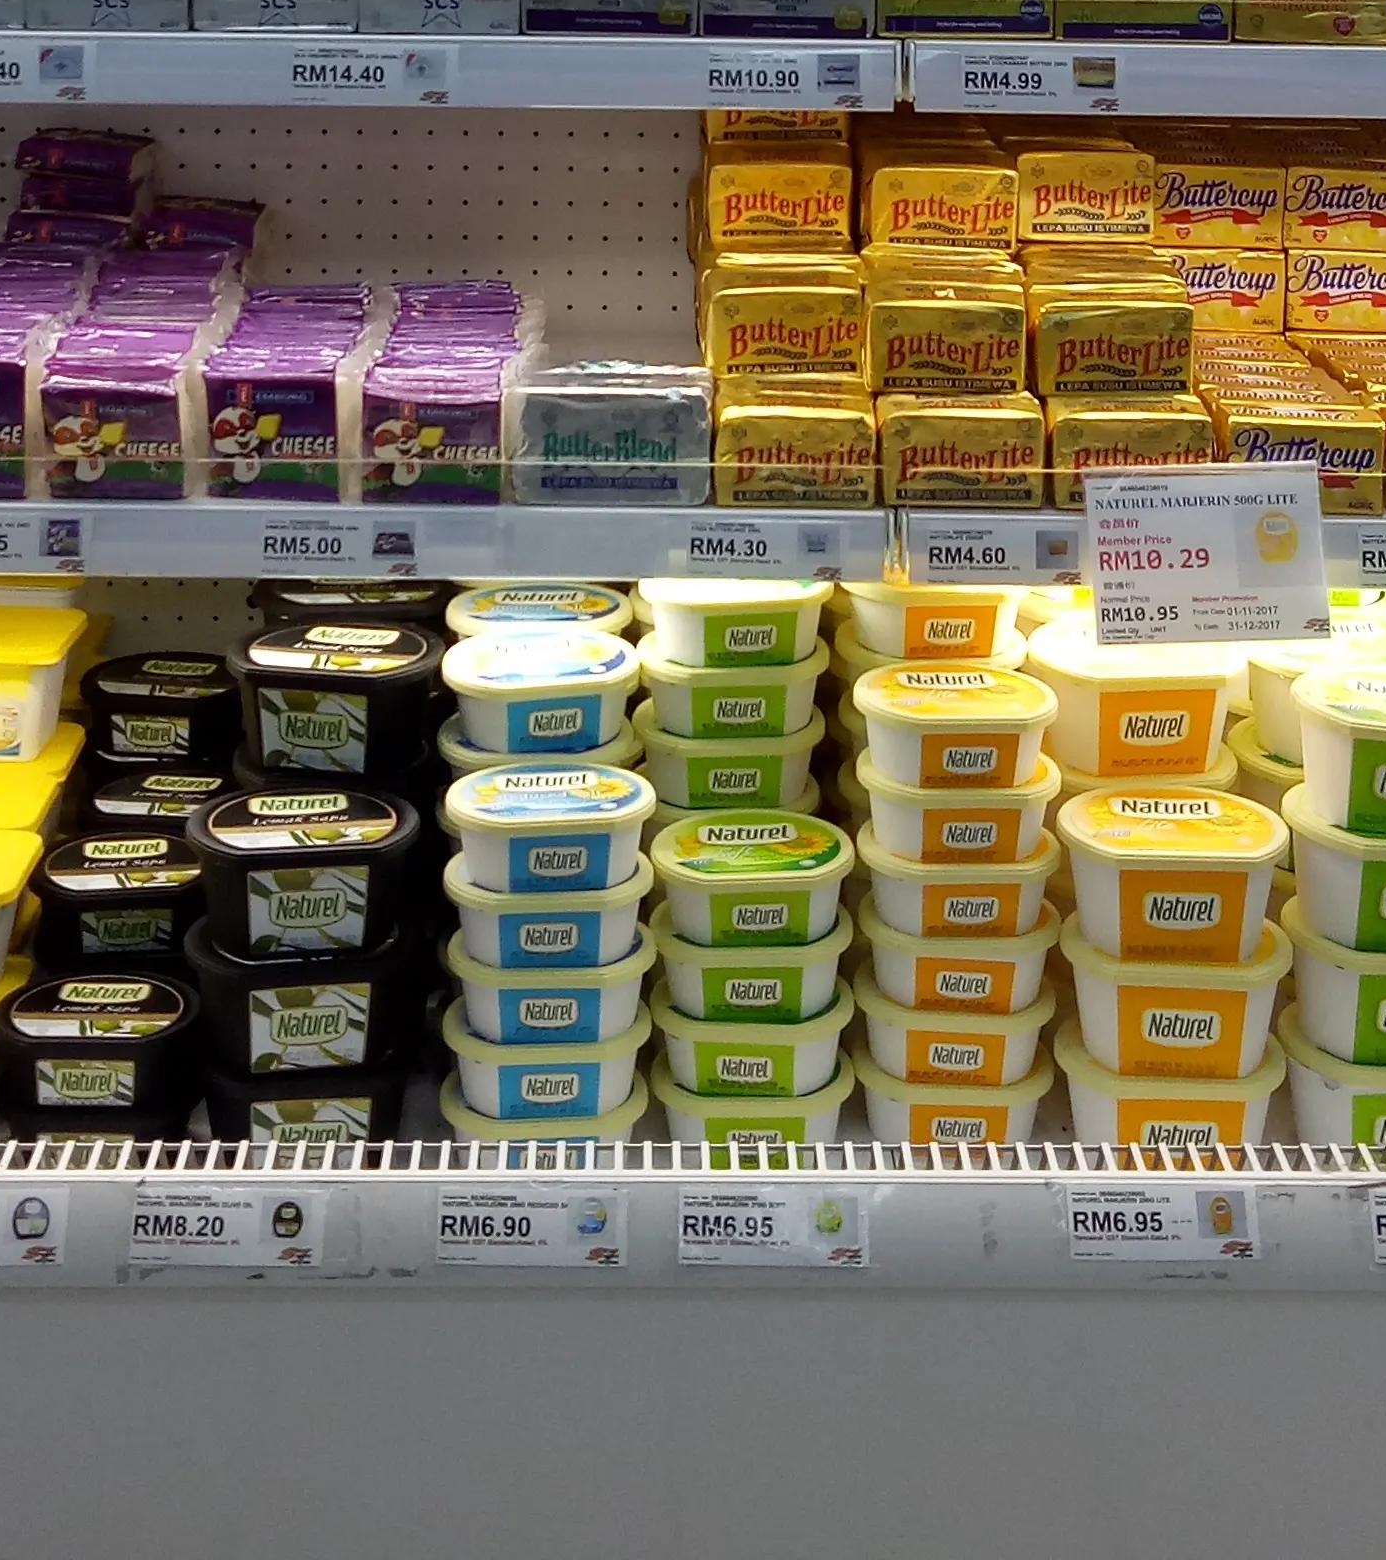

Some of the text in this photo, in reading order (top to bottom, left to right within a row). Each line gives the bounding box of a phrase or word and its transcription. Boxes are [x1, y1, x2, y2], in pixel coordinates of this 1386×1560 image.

[293, 63, 384, 83] RM14.40
[709, 69, 799, 88] RM10.90
[964, 72, 1043, 91] RM4.99
[1035, 181, 1151, 219] ButterLite
[1037, 224, 1145, 233] LEPA SUSU ISTIMEWA
[886, 332, 1020, 370] ButterLite
[271, 436, 335, 455] CHEESE
[1095, 494, 1297, 510] NATUREL MARJERIN 500G LITE
[263, 536, 342, 555] RM5.00
[690, 538, 767, 556] RM4.30
[1098, 535, 1172, 546] Member Price
[929, 546, 1006, 564] RM4.60
[1099, 549, 1209, 571] RM10.29
[1130, 595, 1150, 603] Price
[1101, 606, 1178, 622] RM10.95
[1227, 606, 1278, 615] 01-11-2017
[1229, 621, 1280, 630] 31-12-2017
[259, 795, 339, 811] Naturel
[707, 825, 790, 842] Naturel
[736, 906, 784, 927] Naturel
[61, 1070, 112, 1093] Naturel
[132, 1216, 224, 1238] RM8.20
[440, 1216, 532, 1237] RM6.90
[682, 1216, 774, 1237] RM6.95
[1072, 1211, 1164, 1233] RM6.95
